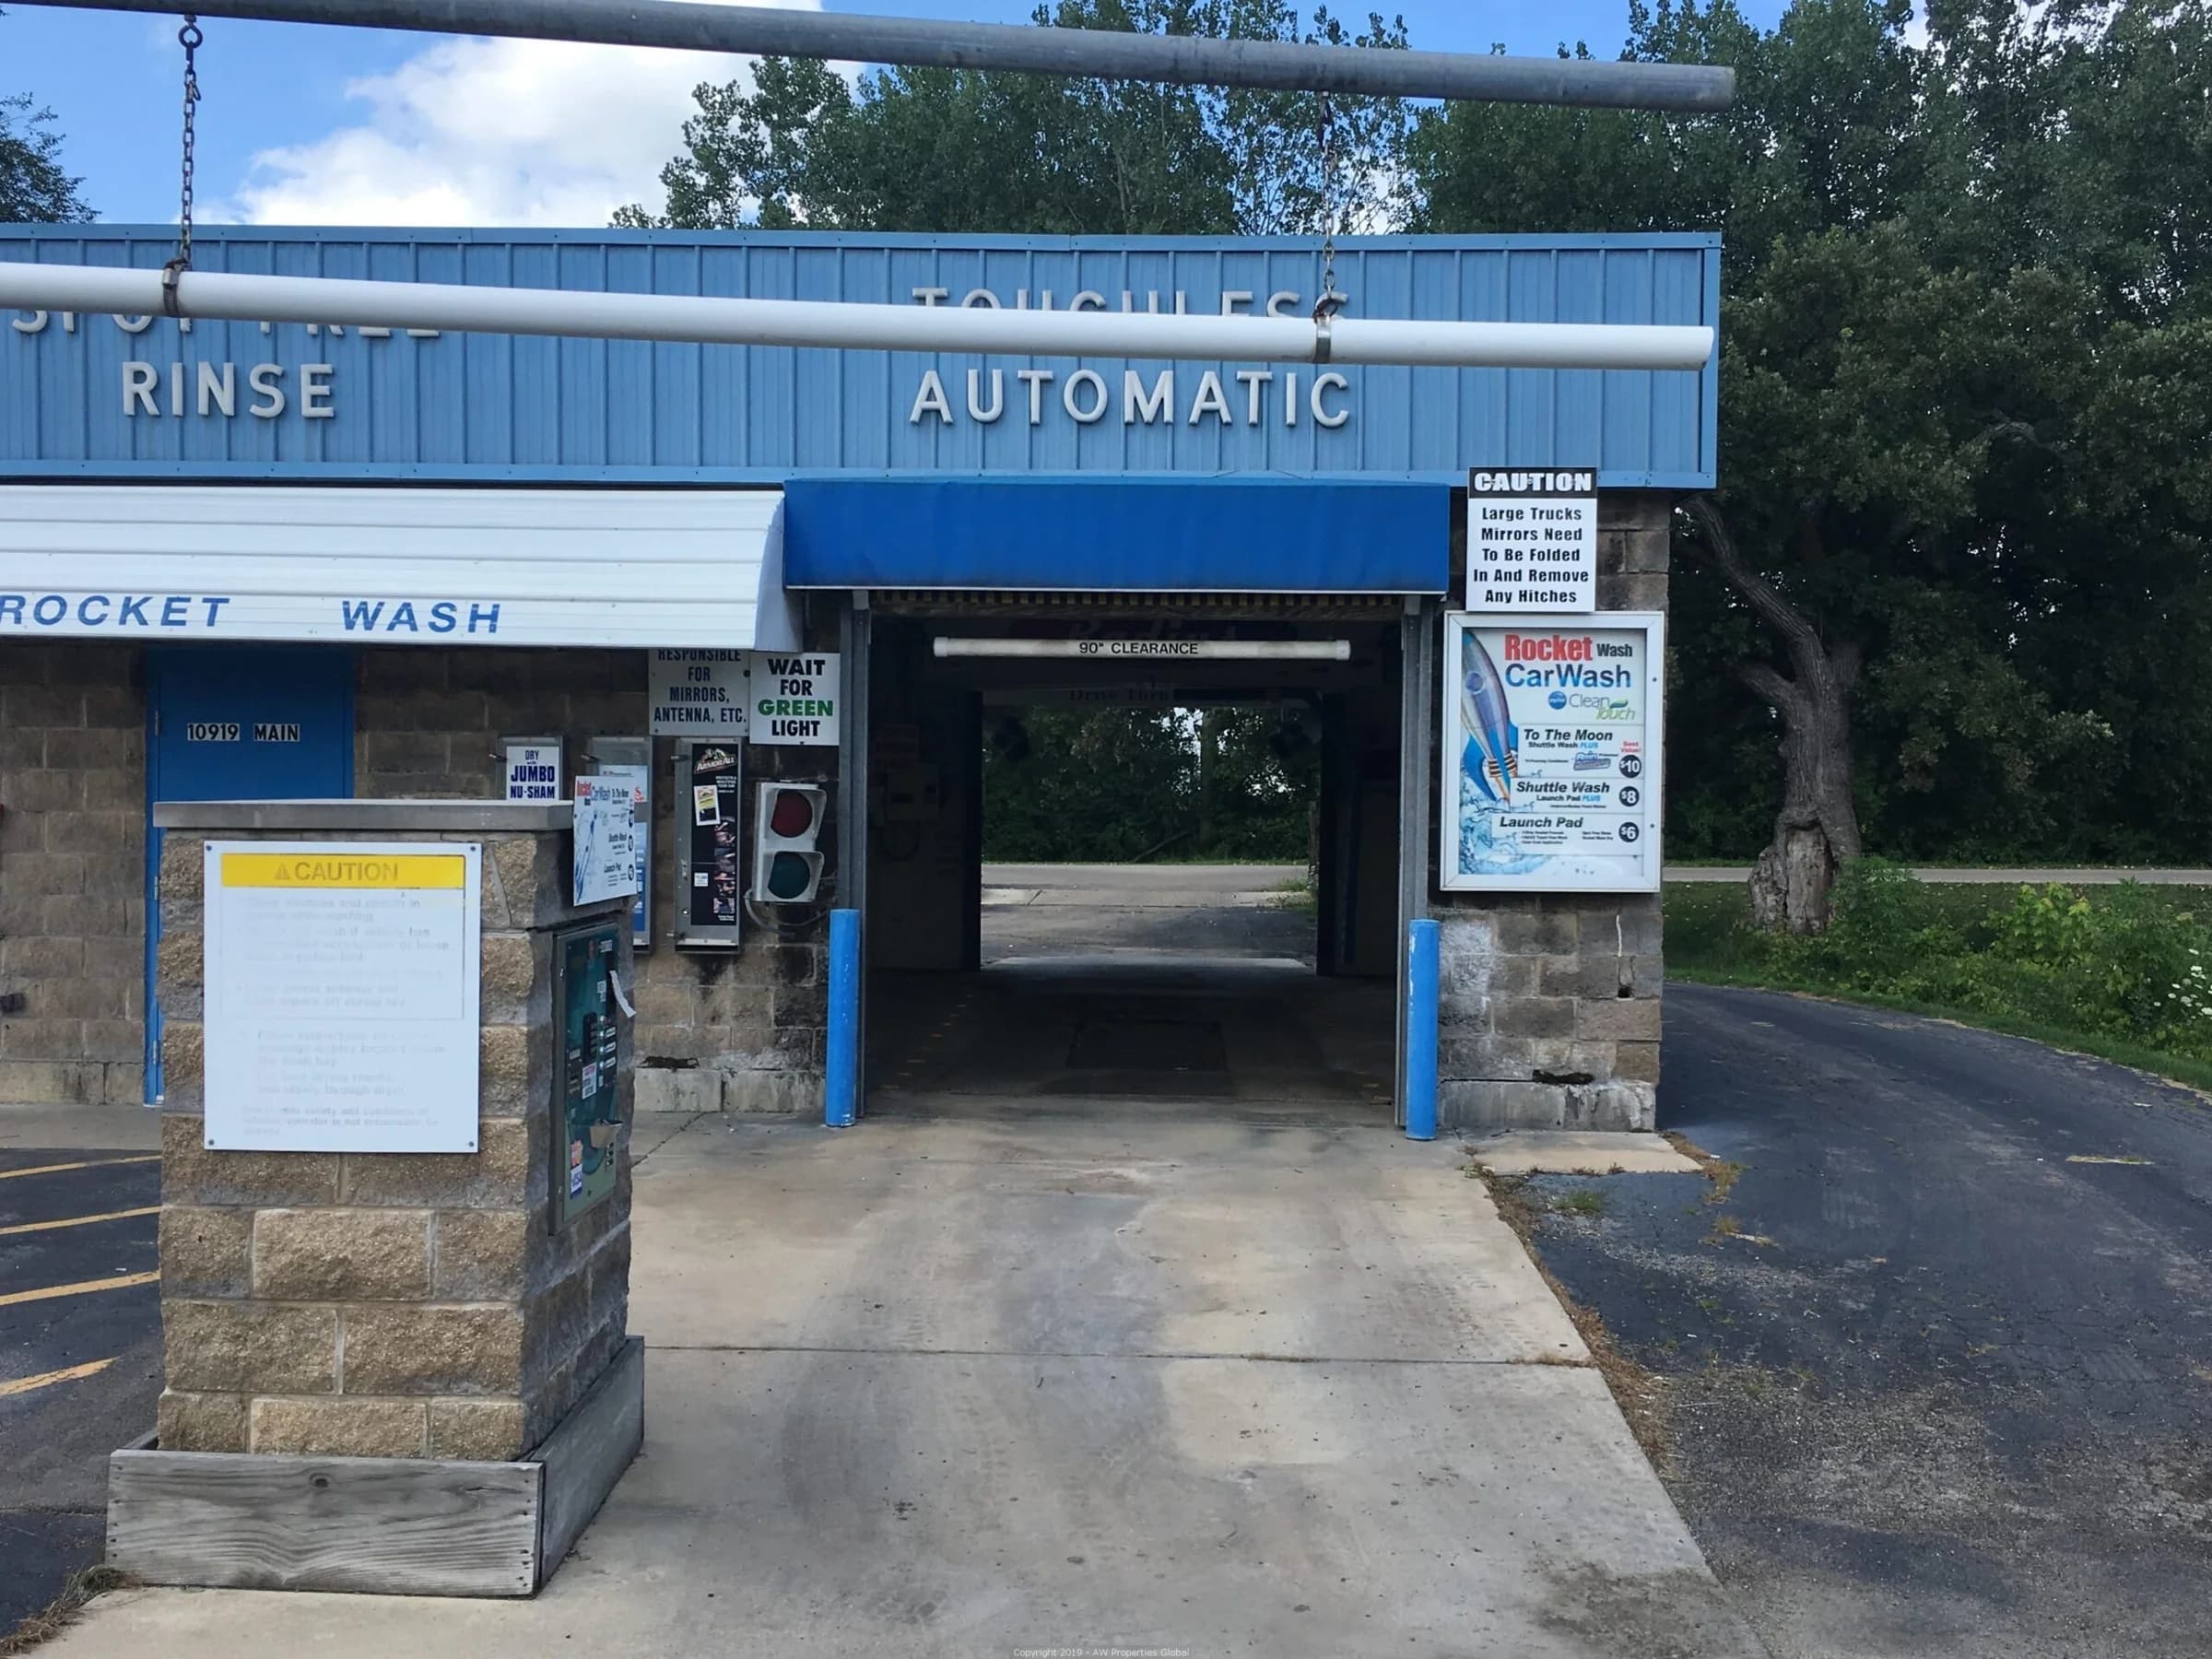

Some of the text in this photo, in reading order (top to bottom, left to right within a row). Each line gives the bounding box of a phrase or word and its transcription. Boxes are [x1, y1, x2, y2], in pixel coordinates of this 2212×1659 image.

[122, 360, 335, 418] RINSE
[909, 369, 1350, 428] AUTOMATIC
[1475, 473, 1592, 491] CAUTION
[1482, 508, 1583, 521] Large Trucks
[1481, 528, 1583, 541] Mirrors Need
[1482, 548, 1580, 561] To Be Folded
[1474, 570, 1589, 582] In And Remove
[1485, 590, 1577, 604] Any Hitches
[0, 594, 500, 633] ROCKET WASH
[1111, 641, 1198, 655] CLEARANCE
[1504, 634, 1632, 661] Rocket Wash
[688, 666, 711, 682] FOR
[768, 659, 826, 676] WAIT
[1505, 663, 1631, 688] CarWash
[669, 687, 730, 703] MIRRORS,
[780, 679, 813, 696] FOR
[758, 700, 833, 716] GREEN
[1569, 693, 1610, 708] Clean
[653, 707, 747, 724] ANTENNA, ETC.
[187, 724, 299, 741] 10919 MAIN
[771, 720, 820, 736] LIGHT
[1524, 729, 1613, 741] To The Moon
[511, 765, 555, 782] JUMBO
[1620, 759, 1641, 773] $10
[1516, 782, 1610, 793] Shuttle Wash
[1621, 790, 1637, 804] $8
[1500, 817, 1583, 828] Launch Pad
[1621, 827, 1636, 840] $6
[294, 862, 398, 881] CAUTION
